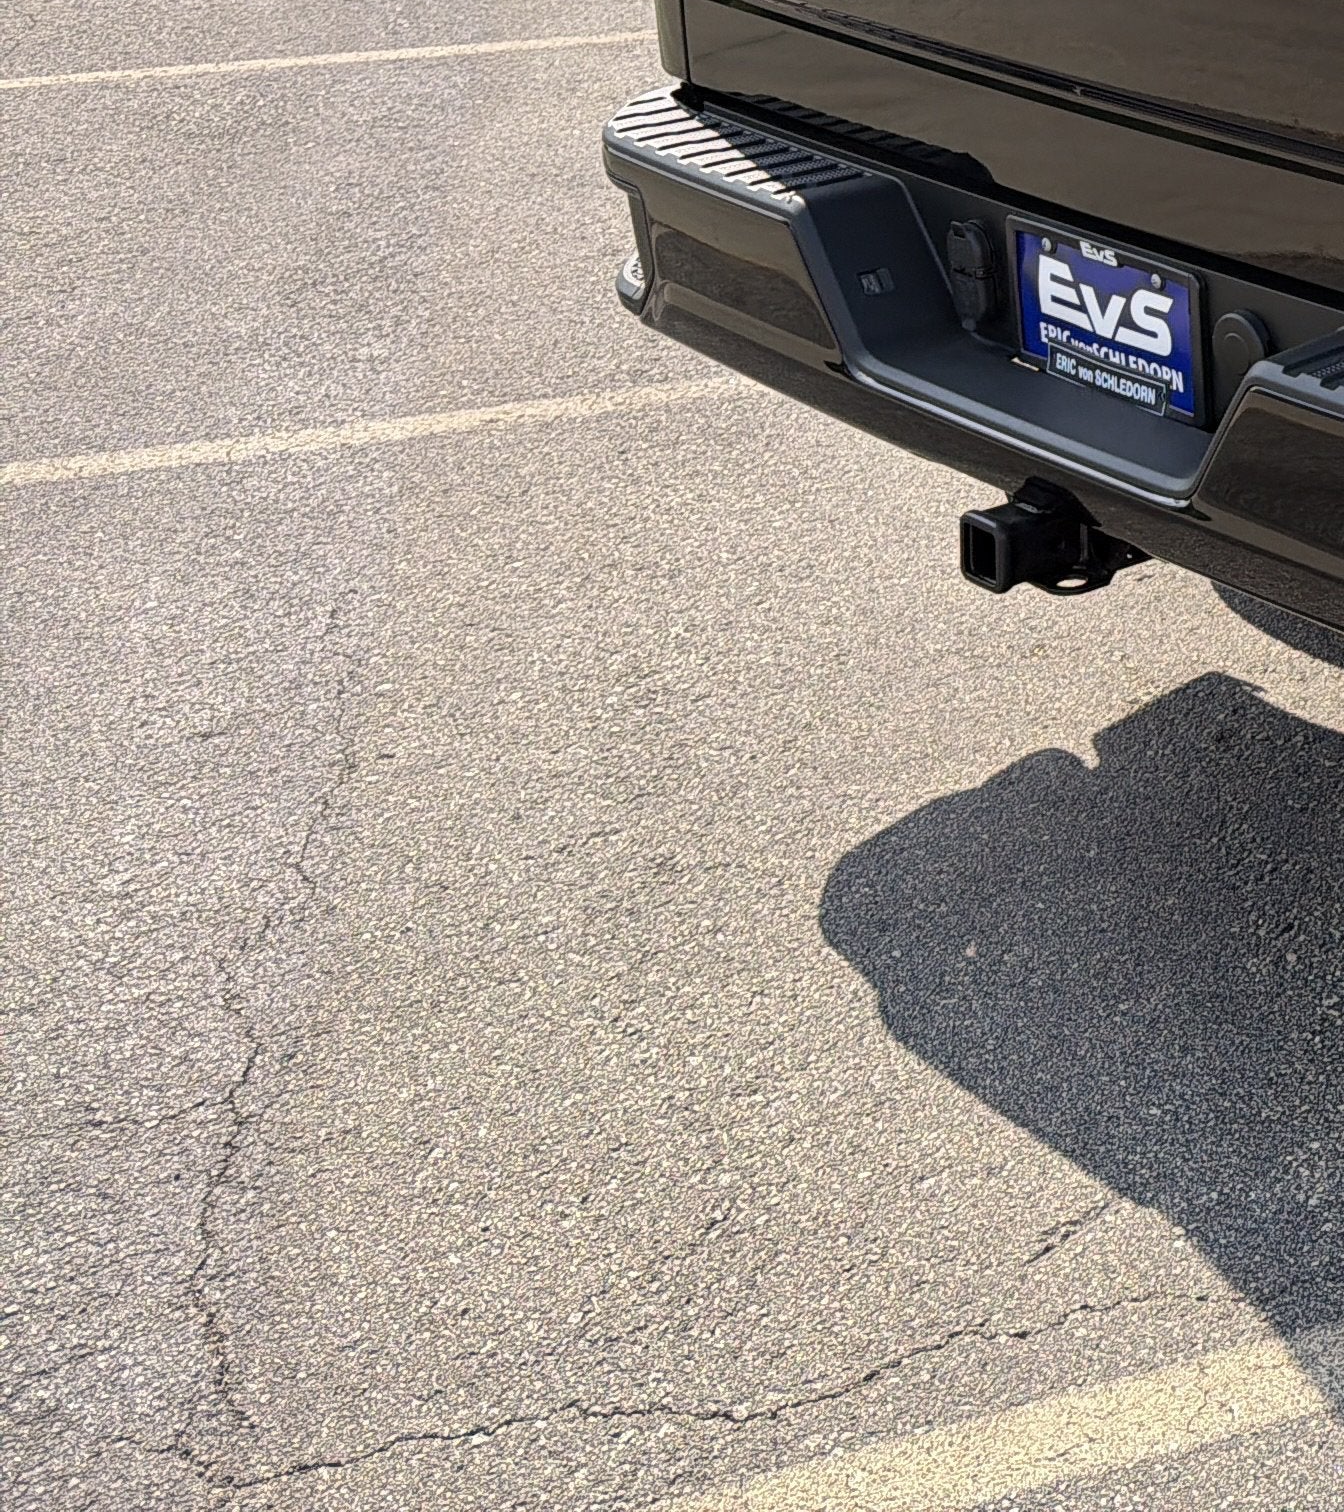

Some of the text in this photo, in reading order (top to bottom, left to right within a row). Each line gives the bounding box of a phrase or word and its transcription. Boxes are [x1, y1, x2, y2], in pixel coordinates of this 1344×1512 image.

[1055, 352, 1156, 406] ERIC von SCHLEDORN
